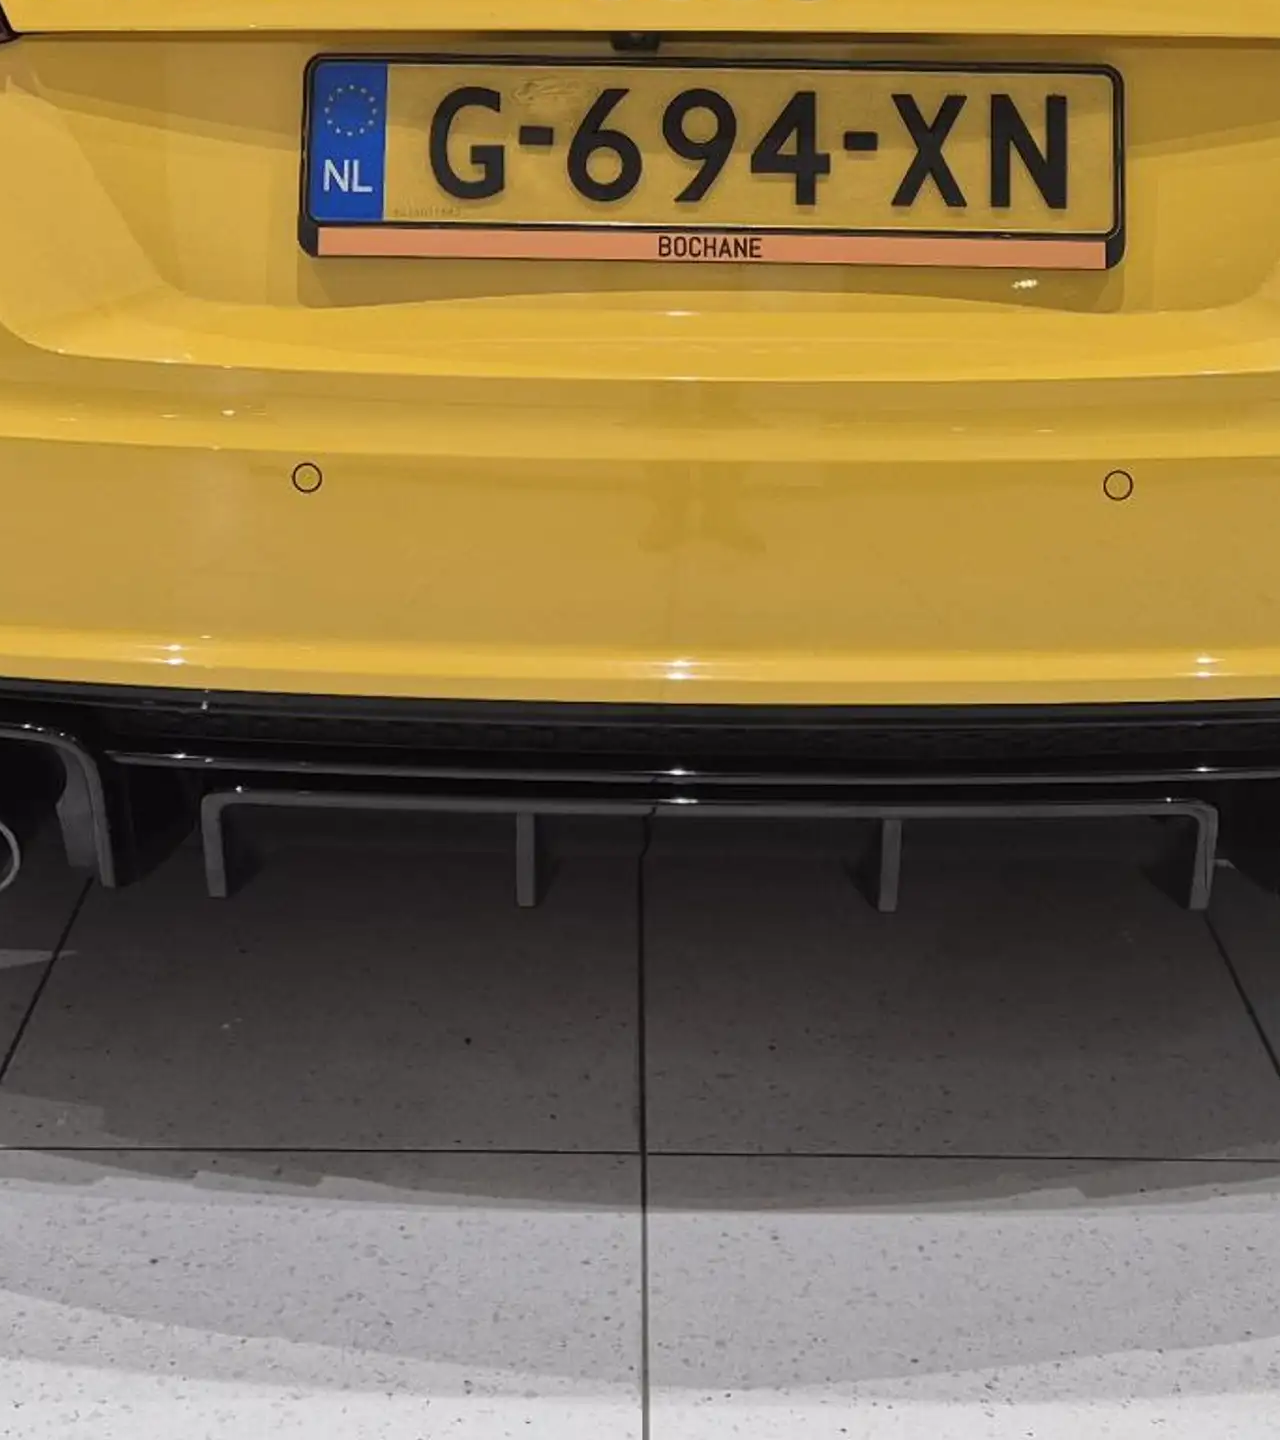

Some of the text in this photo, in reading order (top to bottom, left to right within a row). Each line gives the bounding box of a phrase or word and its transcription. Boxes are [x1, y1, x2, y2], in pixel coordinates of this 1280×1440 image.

[429, 86, 1068, 210] G-694-XN
[322, 158, 374, 194] NL
[657, 235, 763, 259] BOCHANE
